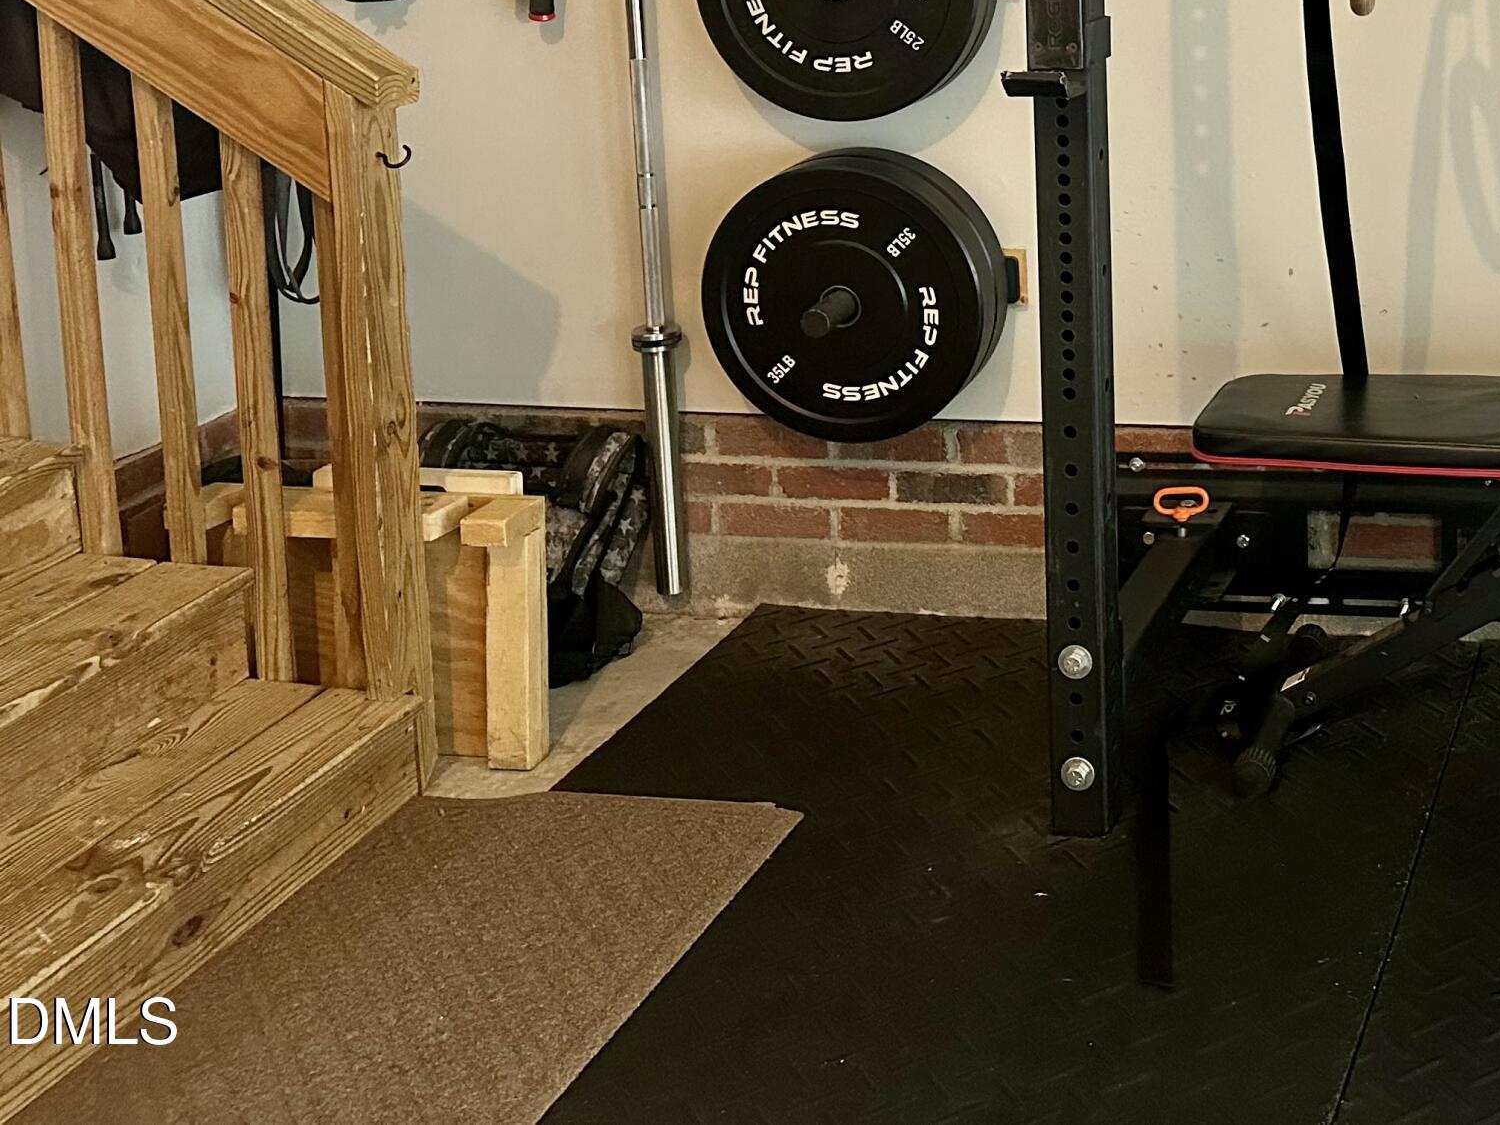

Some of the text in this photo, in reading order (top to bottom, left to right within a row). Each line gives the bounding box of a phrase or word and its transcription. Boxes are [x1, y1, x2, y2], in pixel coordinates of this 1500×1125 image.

[889, 19, 926, 51] 25LB
[813, 51, 873, 73] REP
[886, 226, 917, 258] 35LB
[743, 210, 860, 326] REP FITNESS
[822, 286, 939, 402] REP FITNESS
[767, 354, 796, 384] 35LB
[1285, 383, 1327, 416] PASYOU
